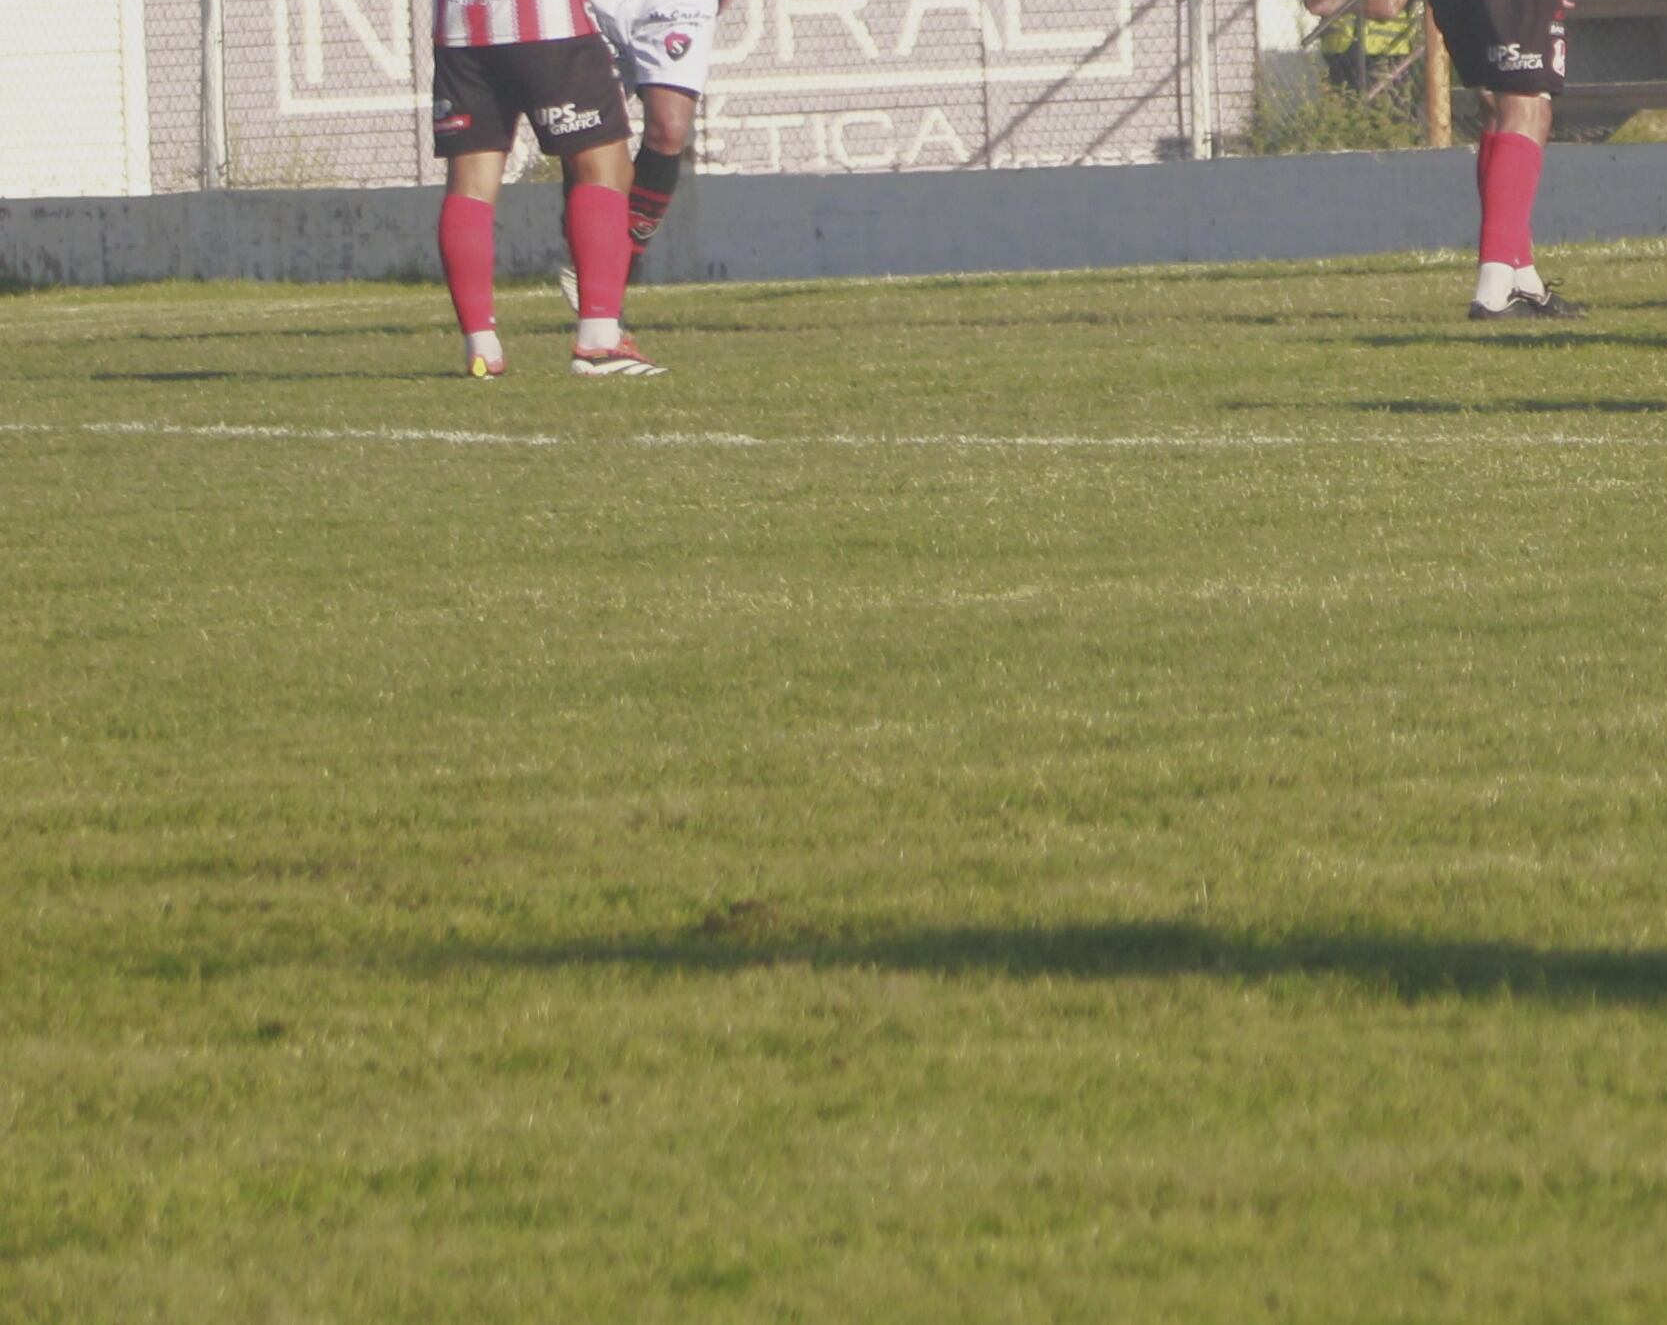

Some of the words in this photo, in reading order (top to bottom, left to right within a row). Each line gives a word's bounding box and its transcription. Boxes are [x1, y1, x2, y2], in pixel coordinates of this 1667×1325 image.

[1488, 43, 1521, 62] UPS
[535, 102, 577, 126] UPS
[550, 115, 602, 135] GRAFICA
